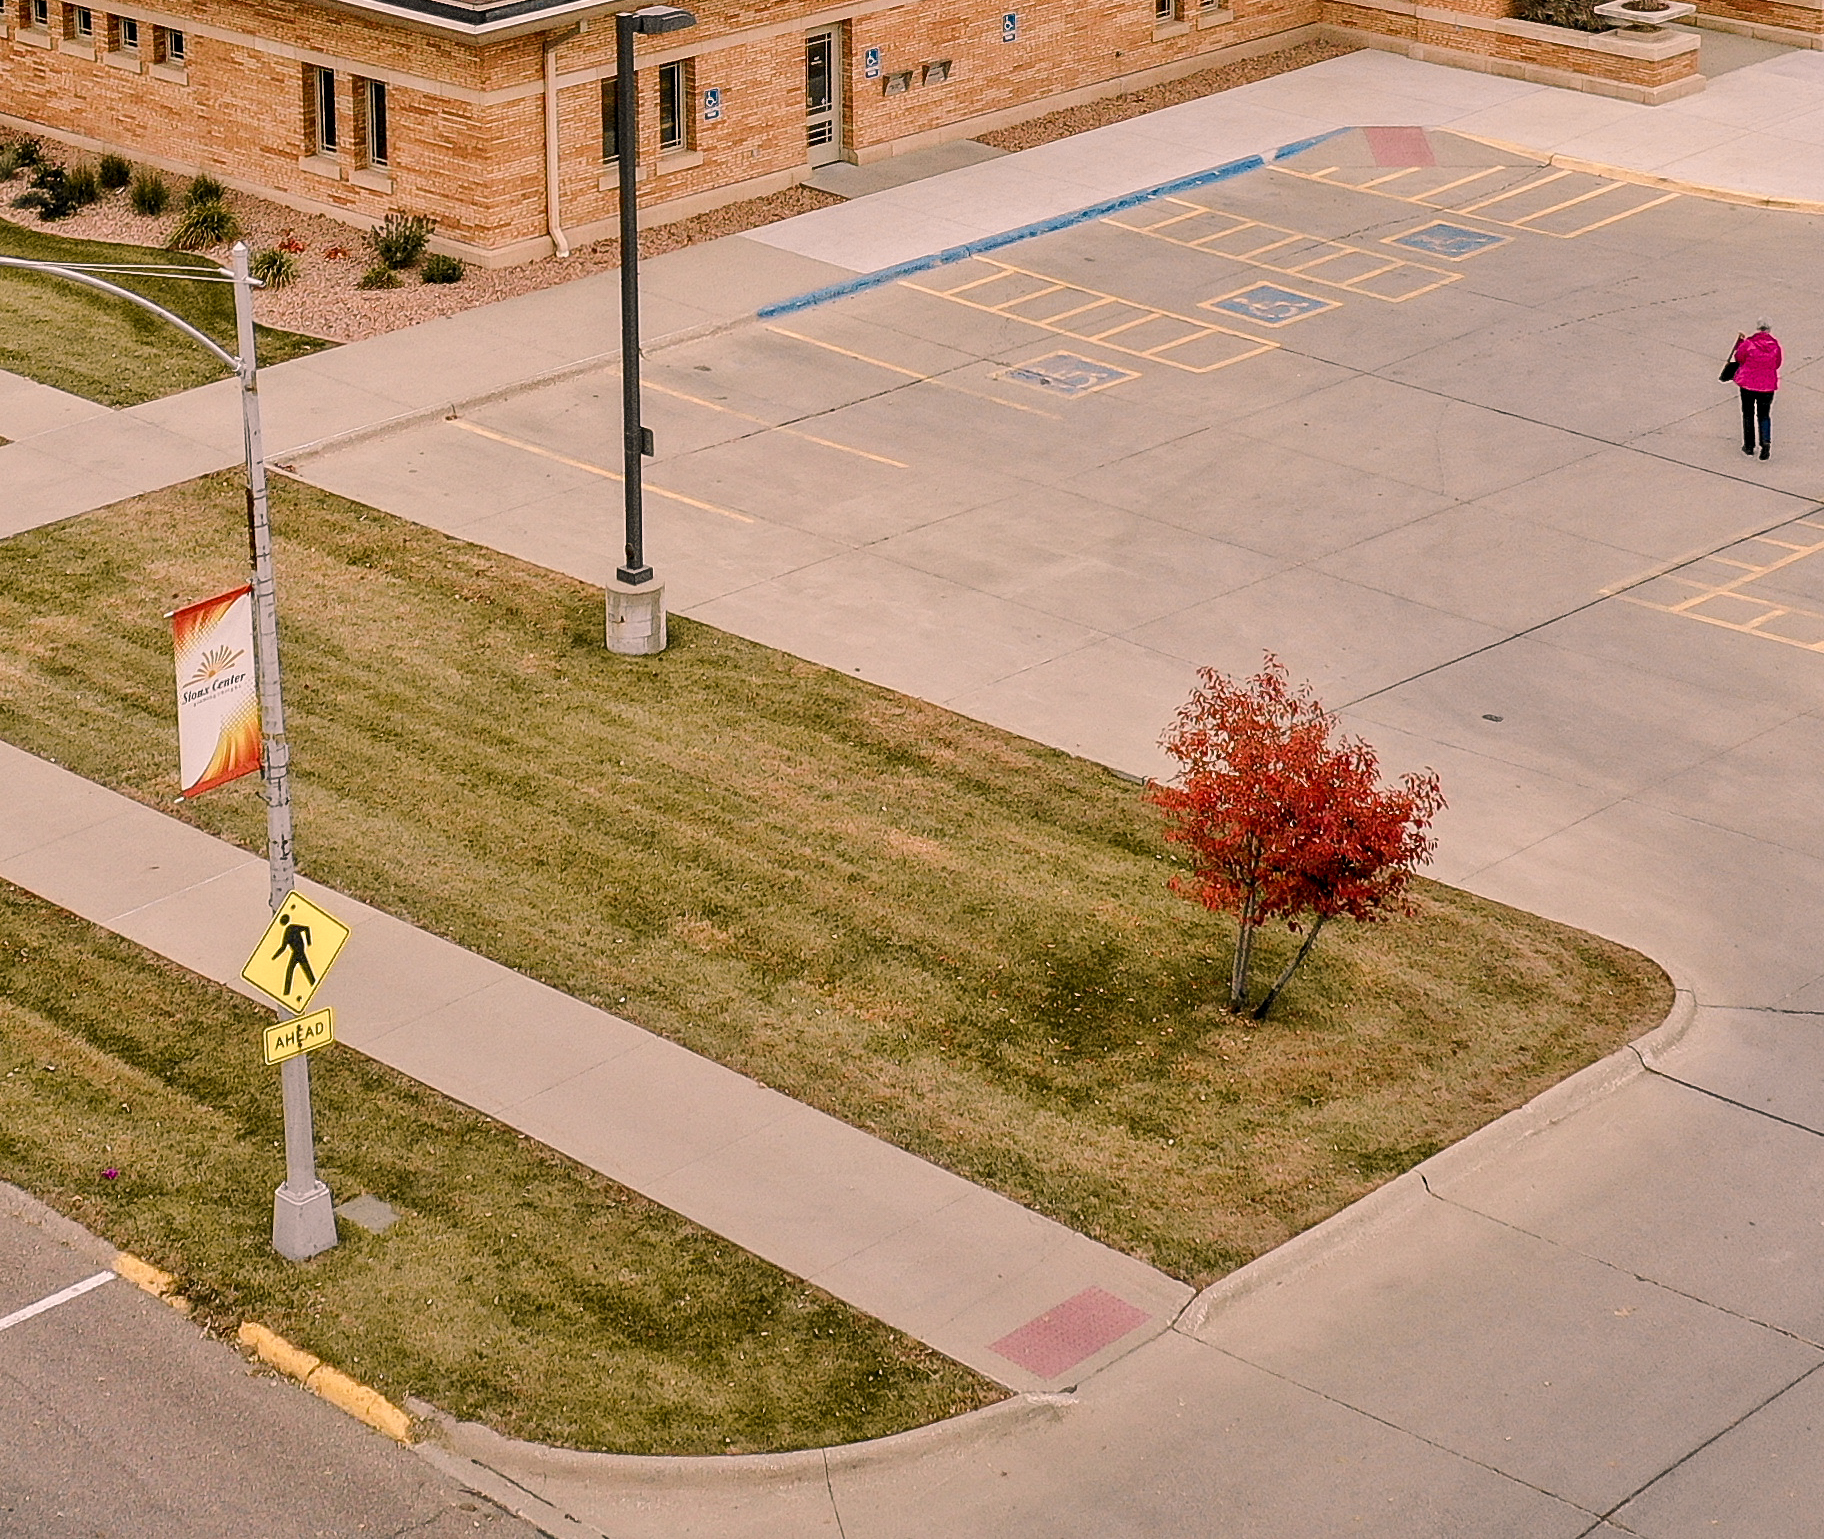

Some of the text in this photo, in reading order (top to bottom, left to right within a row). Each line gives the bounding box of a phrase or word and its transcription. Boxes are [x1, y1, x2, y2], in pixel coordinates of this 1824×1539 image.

[181, 687, 210, 705] Sioux
[212, 672, 246, 691] Center
[274, 1021, 324, 1051] AHEAD
